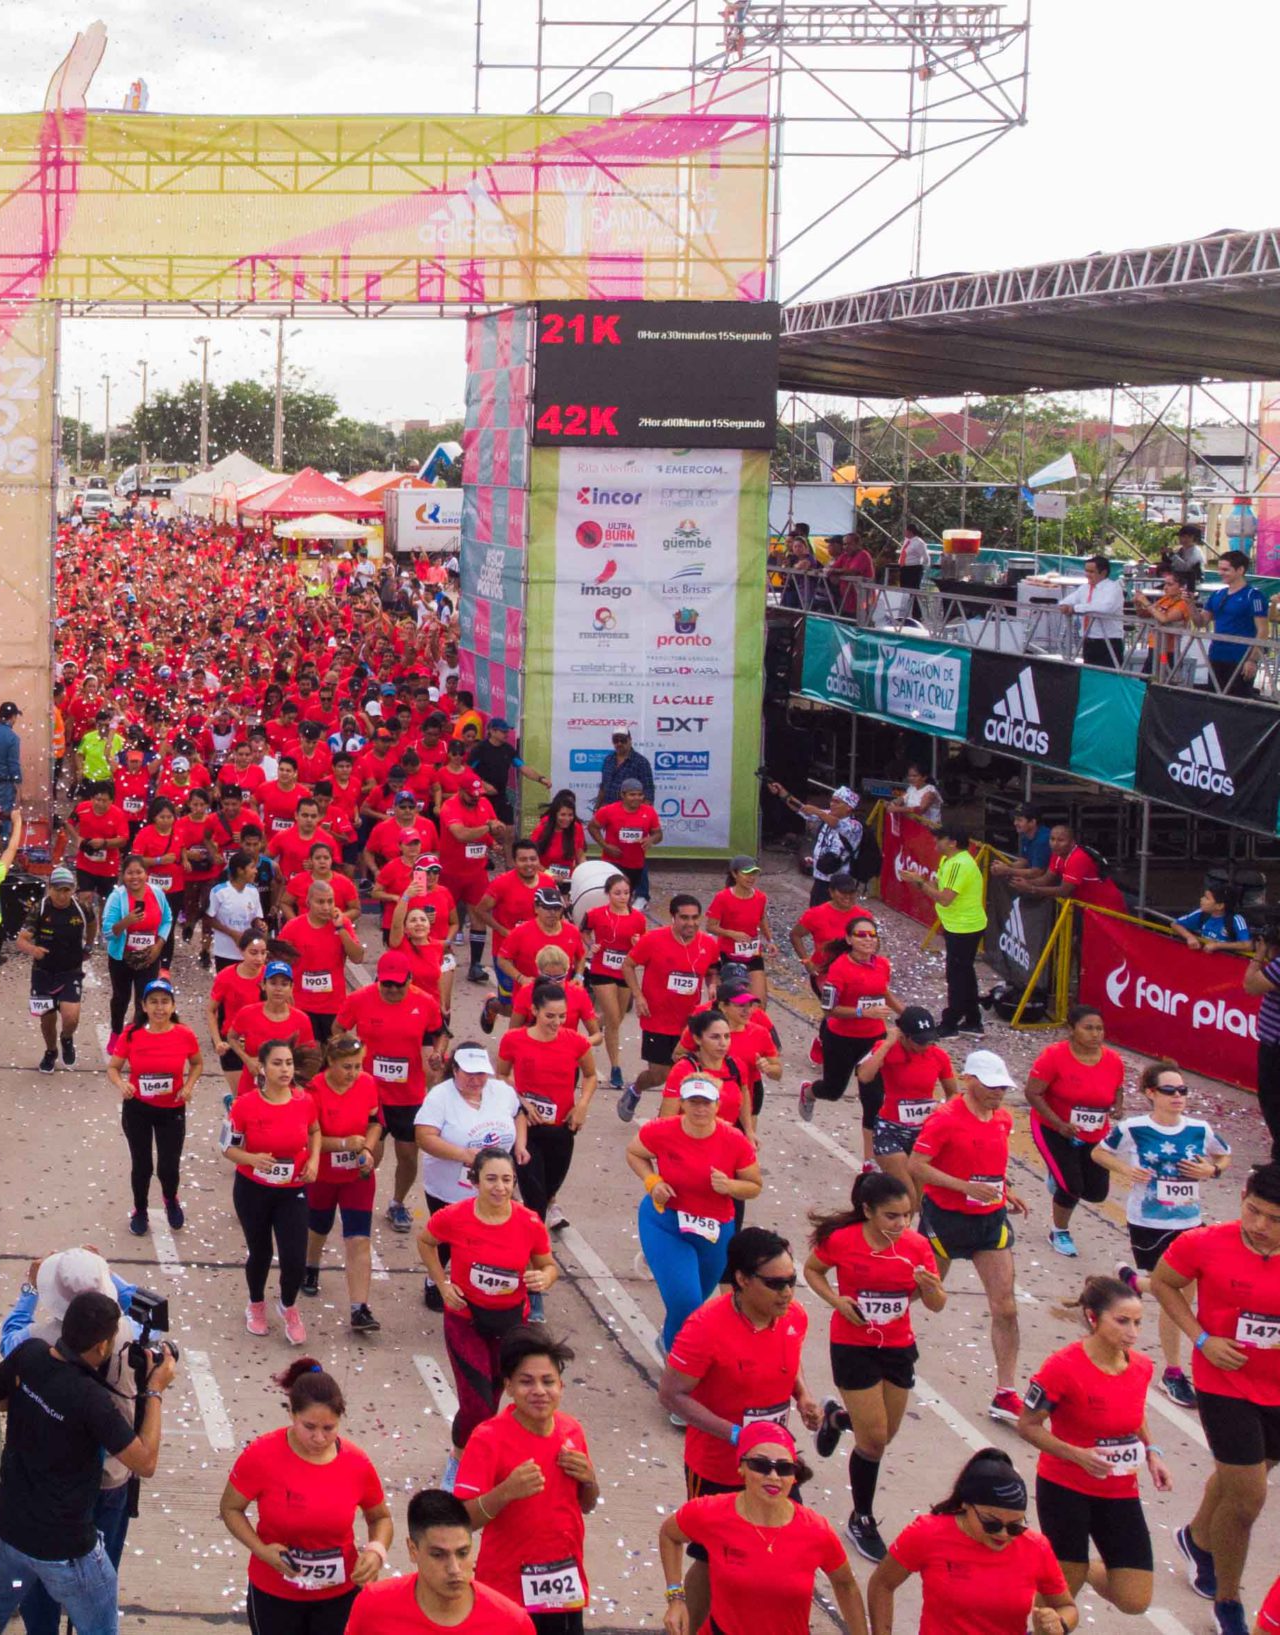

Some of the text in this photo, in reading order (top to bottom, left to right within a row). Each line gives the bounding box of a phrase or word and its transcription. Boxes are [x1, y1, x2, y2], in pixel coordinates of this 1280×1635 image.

[420, 223, 518, 245] adidas
[540, 313, 622, 345] 21K
[536, 405, 619, 437] 42K
[592, 487, 642, 505] incor
[605, 530, 635, 540] BURN
[663, 538, 712, 551] güembé
[580, 583, 632, 599] imago
[662, 584, 712, 595] Las Brisas
[657, 634, 712, 648] pronto
[826, 675, 861, 699] adidas
[892, 676, 955, 711] SANTA CRUZ
[573, 692, 634, 704] EL DEBER
[652, 696, 715, 705] LA CALLE
[656, 717, 709, 732] DXT
[984, 718, 1049, 755] adidas
[677, 755, 708, 764] PLAN
[1168, 762, 1235, 797] adidas
[1000, 932, 1031, 971] adidas
[305, 977, 327, 986] 1903
[673, 979, 696, 989] 1125
[1136, 976, 1189, 1016] fair
[379, 1064, 403, 1074] 1159
[142, 1082, 169, 1092] 1684
[905, 1107, 931, 1119] 1144
[1076, 1113, 1103, 1125] 1984
[1166, 1185, 1194, 1196] 1901
[684, 1213, 715, 1230] 1758
[865, 1300, 902, 1313] 1788
[1245, 1323, 1280, 1338] 147
[301, 1564, 337, 1579] 757
[530, 1577, 575, 1595] 1492
